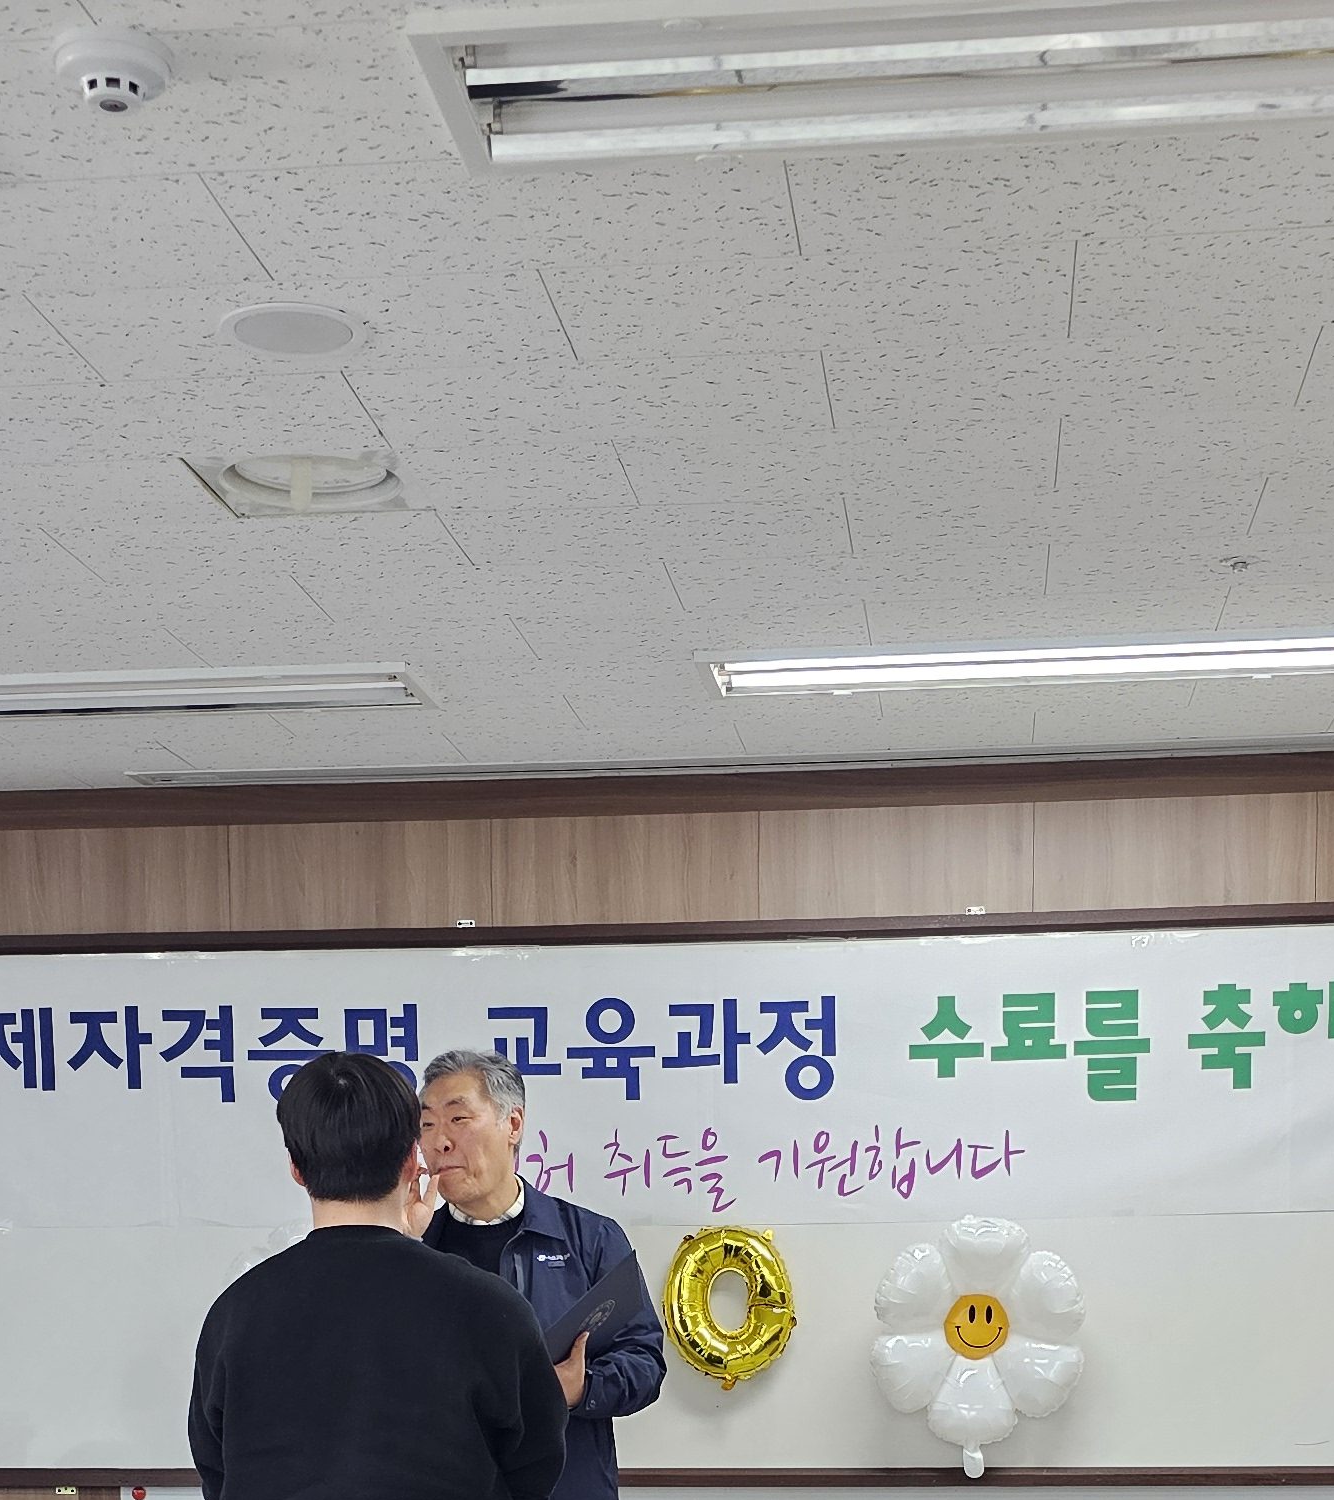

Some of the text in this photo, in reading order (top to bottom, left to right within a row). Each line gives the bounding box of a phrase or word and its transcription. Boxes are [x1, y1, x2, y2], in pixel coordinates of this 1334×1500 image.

[488, 995, 837, 1100] 교육과정
[909, 991, 1151, 1101] 수료를
[513, 1124, 1025, 1213] 허 취득을 기원합니다
